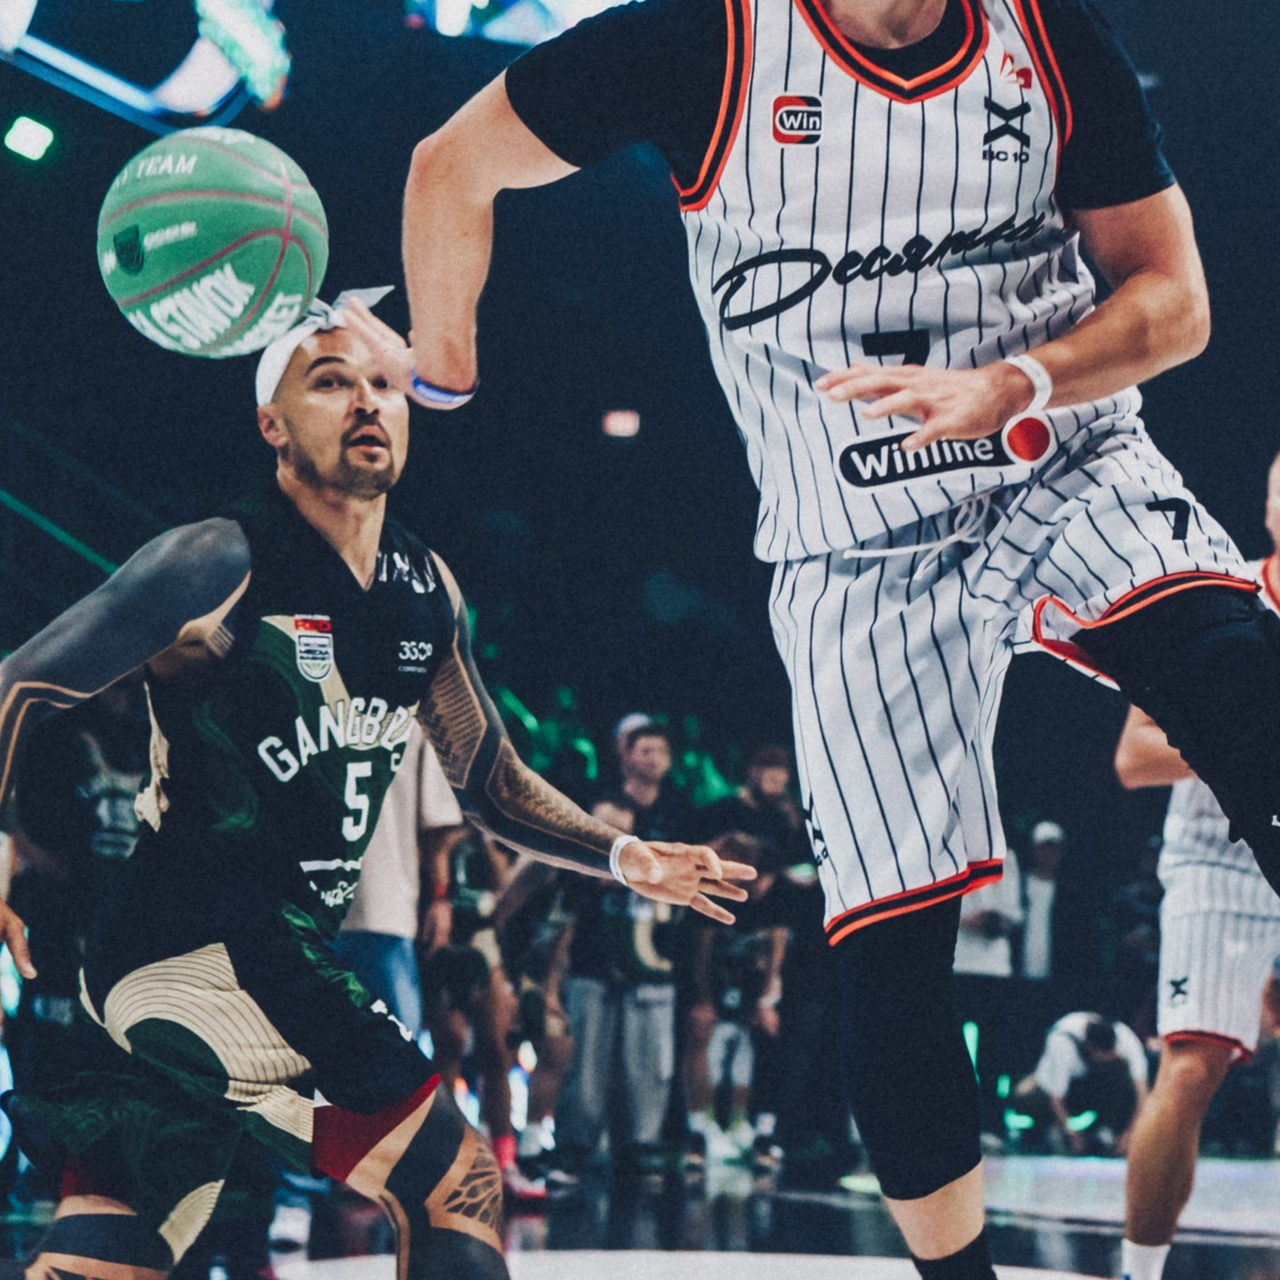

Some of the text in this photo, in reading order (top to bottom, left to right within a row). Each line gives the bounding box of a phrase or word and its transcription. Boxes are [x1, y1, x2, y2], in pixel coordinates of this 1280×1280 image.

[782, 112, 820, 130] Win
[982, 150, 1030, 163] BC 10
[850, 437, 994, 481] Winline
[1146, 498, 1191, 540] 7
[257, 696, 414, 783] GANGBO
[342, 761, 373, 842] 5
